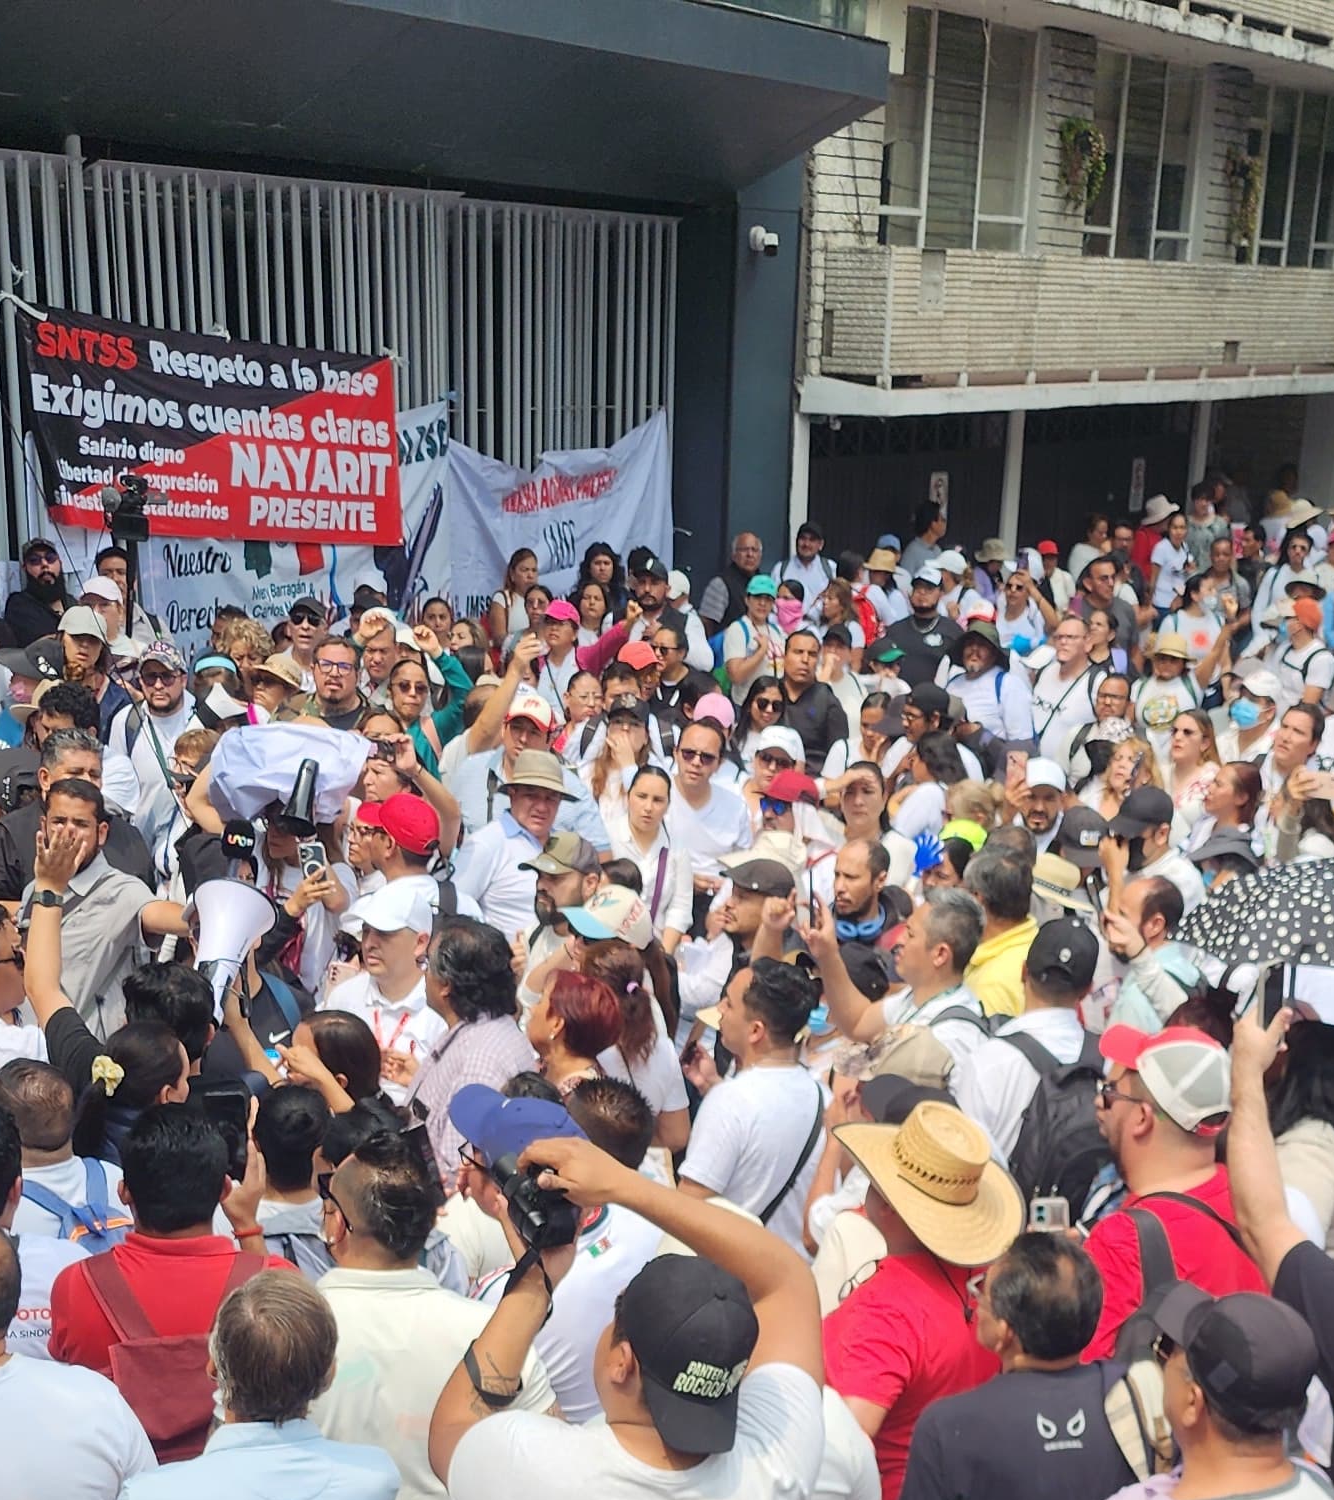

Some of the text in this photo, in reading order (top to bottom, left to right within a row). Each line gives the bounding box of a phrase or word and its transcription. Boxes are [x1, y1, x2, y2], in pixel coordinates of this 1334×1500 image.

[36, 321, 379, 398] SNTSS Respeto a la base
[30, 373, 184, 429] Exigimos
[187, 402, 305, 443] cuentas
[310, 409, 391, 448] claras
[78, 435, 186, 467] Salario digno
[229, 441, 392, 497] NAYARIT
[144, 470, 219, 495] expresión
[142, 498, 229, 520] statutarios
[248, 495, 378, 533] PRESENTE
[163, 543, 232, 579] Nuestro
[167, 596, 220, 634] Derec
